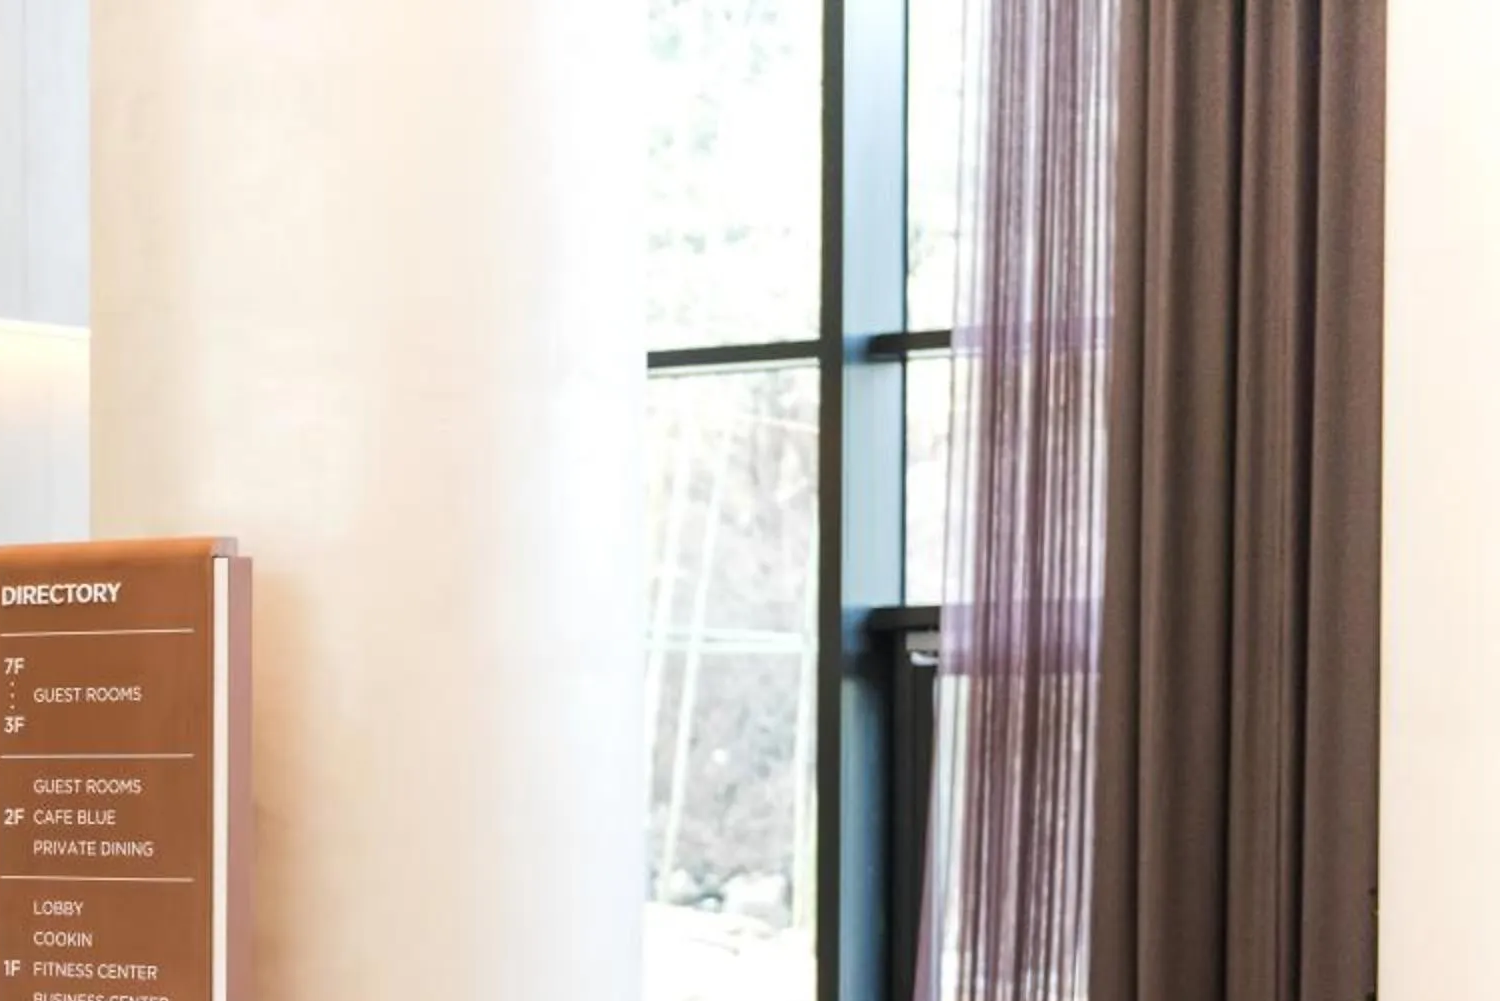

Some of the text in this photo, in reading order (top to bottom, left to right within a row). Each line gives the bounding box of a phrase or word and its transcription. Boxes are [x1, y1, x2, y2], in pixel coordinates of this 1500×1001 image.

[1, 582, 122, 606] DIRECTORY
[3, 657, 25, 675] 7F
[33, 685, 143, 704] GUEST ROOMS
[3, 715, 25, 734] 3F
[33, 778, 143, 795] GUEST ROOMS
[3, 807, 116, 826] 2F CAFE BLUE
[33, 839, 154, 857] PRIVATE DINING
[33, 900, 84, 917] LOBBY
[33, 930, 93, 947] COOKIN
[3, 959, 158, 981] 1F FITNESS CENTER
